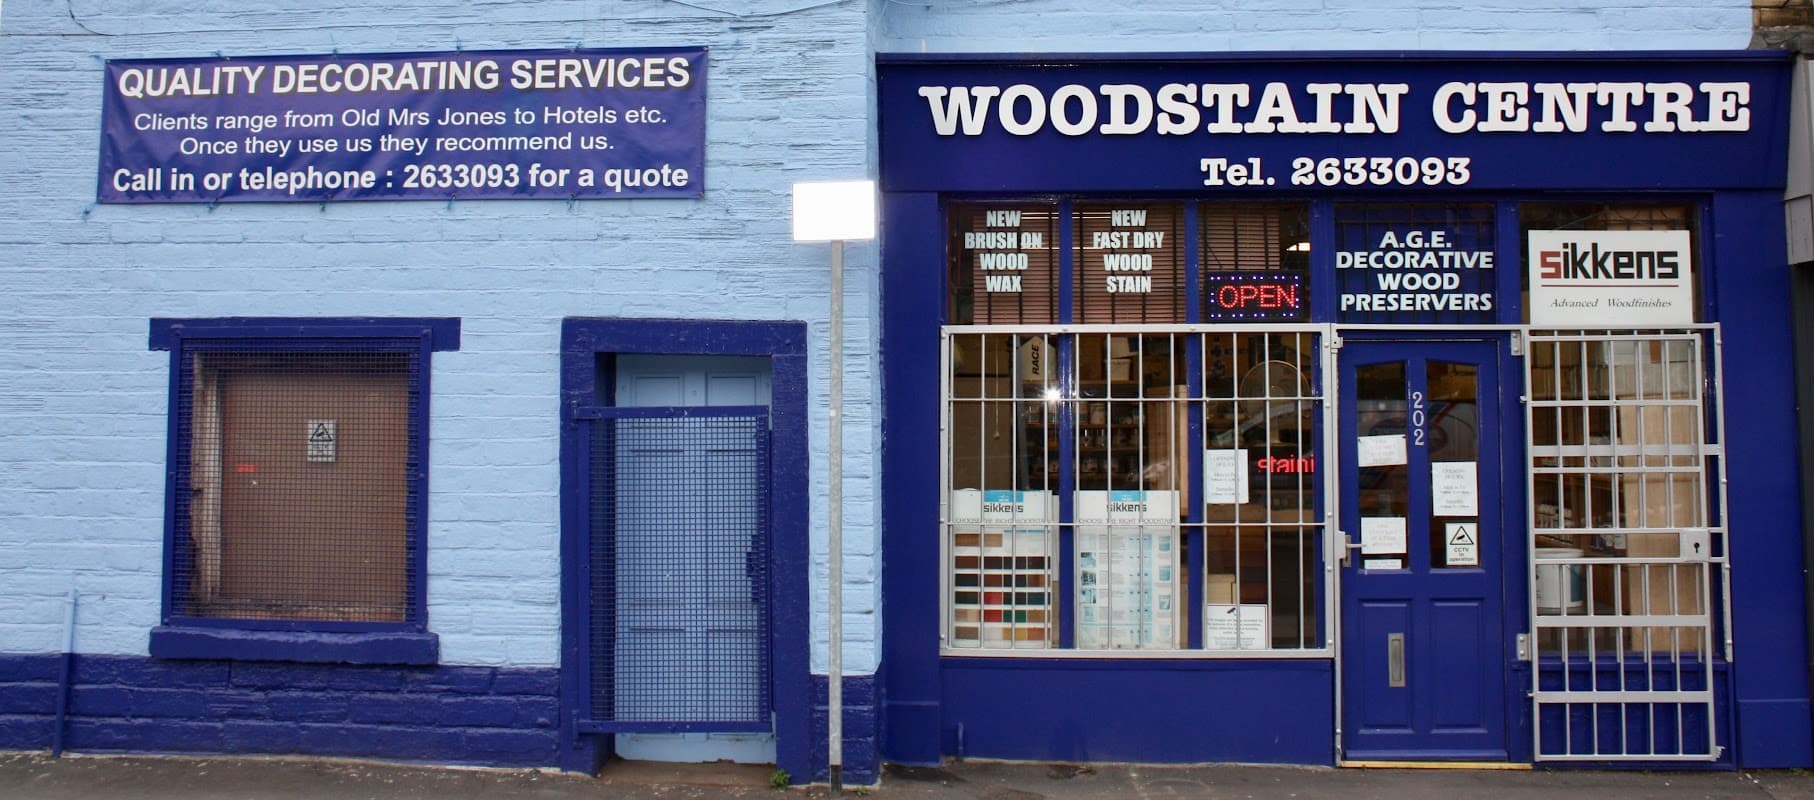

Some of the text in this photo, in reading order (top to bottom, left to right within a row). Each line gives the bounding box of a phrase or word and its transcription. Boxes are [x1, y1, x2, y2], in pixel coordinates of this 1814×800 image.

[119, 56, 690, 98] QUALITY DECORATING SERVICES
[919, 82, 1750, 136] WOODSTAIN CENTRE
[134, 105, 667, 134] Clients range from Old Mrs Jones to Hotels etc.
[180, 132, 614, 158] Once they use us they recommend us.
[113, 162, 689, 194] Call in or telephone : 2633093 for a quote
[1201, 157, 1470, 187] Tel. 2633093
[986, 210, 1022, 227] NEW
[1111, 210, 1147, 227] NEW
[964, 232, 1043, 249] BRUSH ON
[1093, 231, 1165, 249] FAST DRY
[1379, 230, 1452, 249] A.G.E.
[979, 253, 1029, 271] WOOD
[1103, 253, 1153, 271] WOOD
[1335, 251, 1494, 269] DECORATIVE
[1540, 242, 1680, 279] sikkens
[985, 275, 1022, 293] WAX
[1106, 275, 1152, 293] STAIN
[1377, 272, 1460, 291] WOOD
[1219, 284, 1295, 309] OPEN
[1341, 293, 1492, 311] PRESERVERS
[1550, 298, 1673, 308] Advanced Woodfinishes
[1031, 344, 1040, 376] RACE
[1412, 391, 1425, 446] 202
